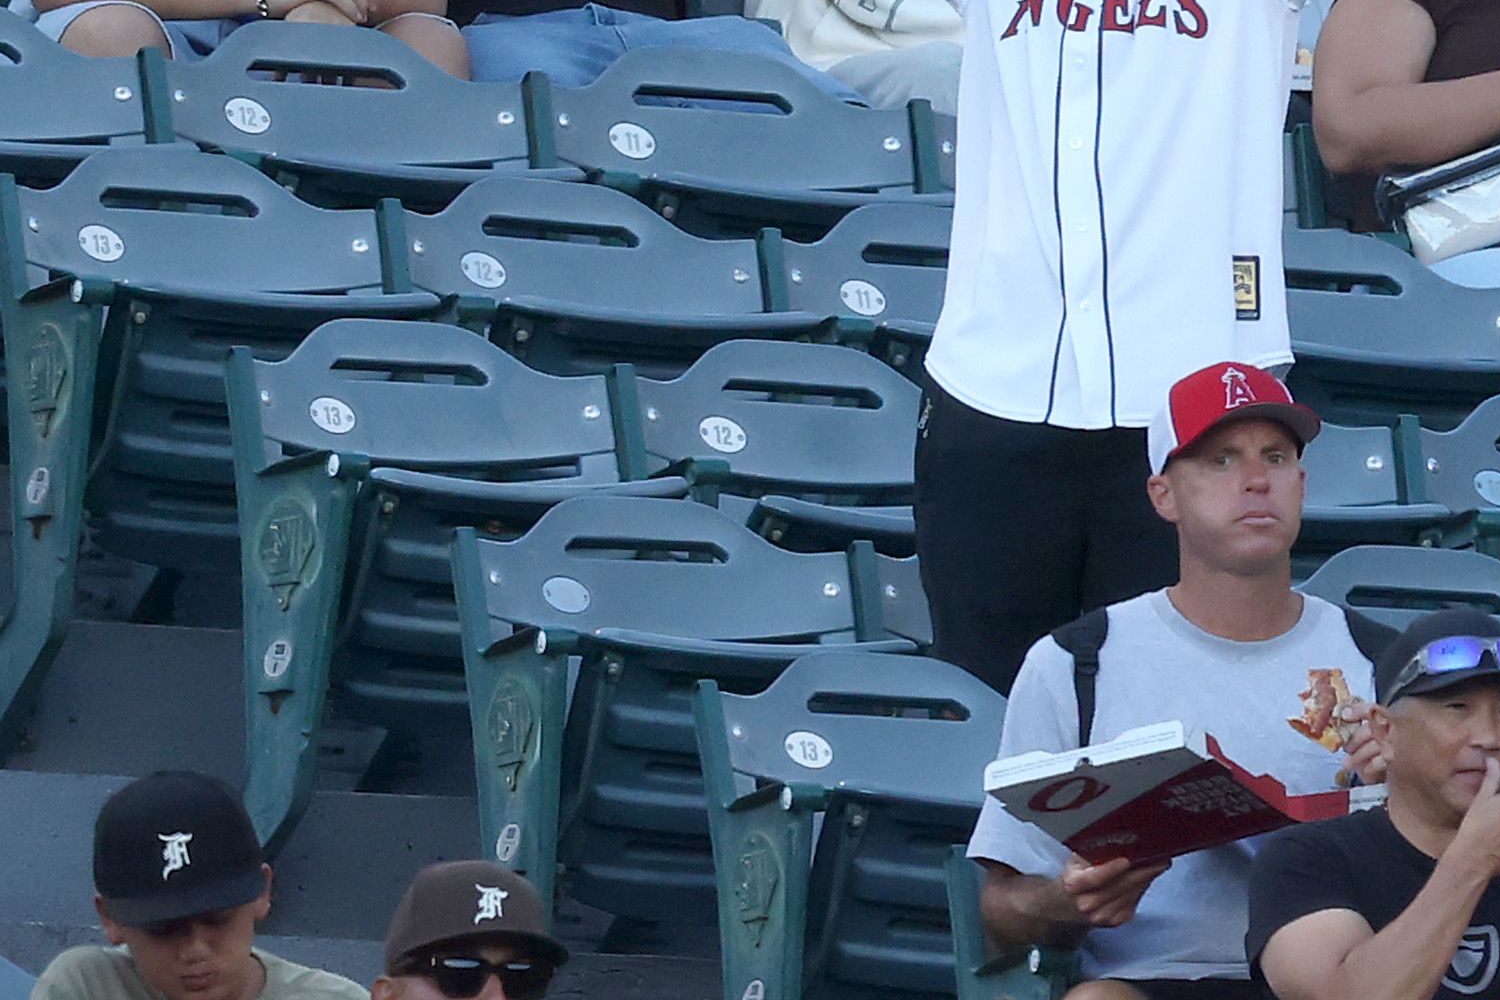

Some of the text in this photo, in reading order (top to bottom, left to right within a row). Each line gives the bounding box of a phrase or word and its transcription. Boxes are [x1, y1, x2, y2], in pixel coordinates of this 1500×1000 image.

[239, 107, 257, 126] 12
[625, 132, 640, 151] 11
[92, 234, 110, 253] 13
[475, 261, 492, 280] 12
[855, 290, 872, 309] 11
[1221, 367, 1256, 408] A
[323, 406, 341, 426] 13
[714, 426, 732, 446] 12
[799, 740, 818, 761] 13
